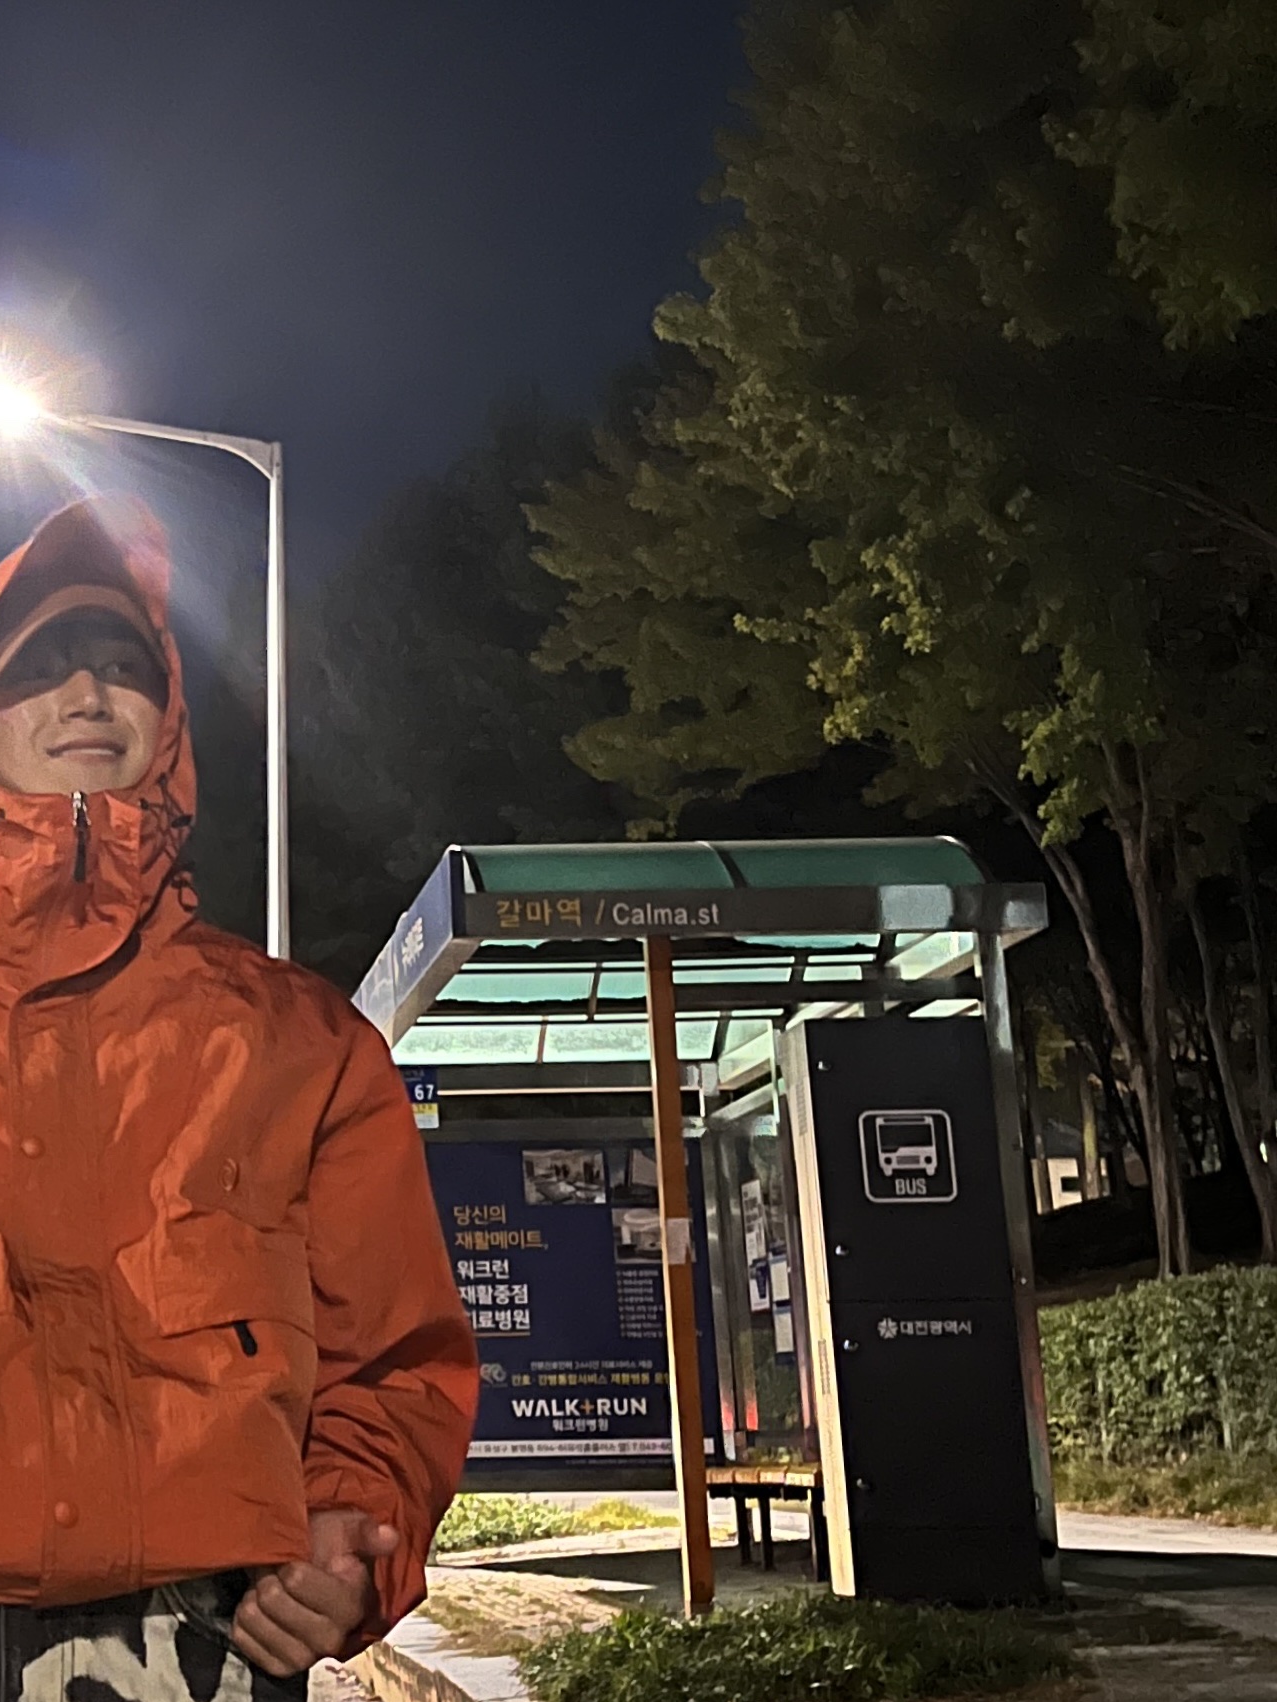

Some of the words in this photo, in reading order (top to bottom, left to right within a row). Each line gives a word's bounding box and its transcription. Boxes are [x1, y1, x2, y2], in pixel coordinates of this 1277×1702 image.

[495, 897, 582, 928] 갈마역
[612, 902, 720, 926] Calma.st
[894, 1178, 927, 1195] BUS
[453, 1203, 507, 1226] 당신의
[454, 1229, 549, 1250] 재활메이트,
[456, 1258, 510, 1280] 워크런
[458, 1283, 529, 1306] 재활중점
[899, 1319, 973, 1336] 대전광역시
